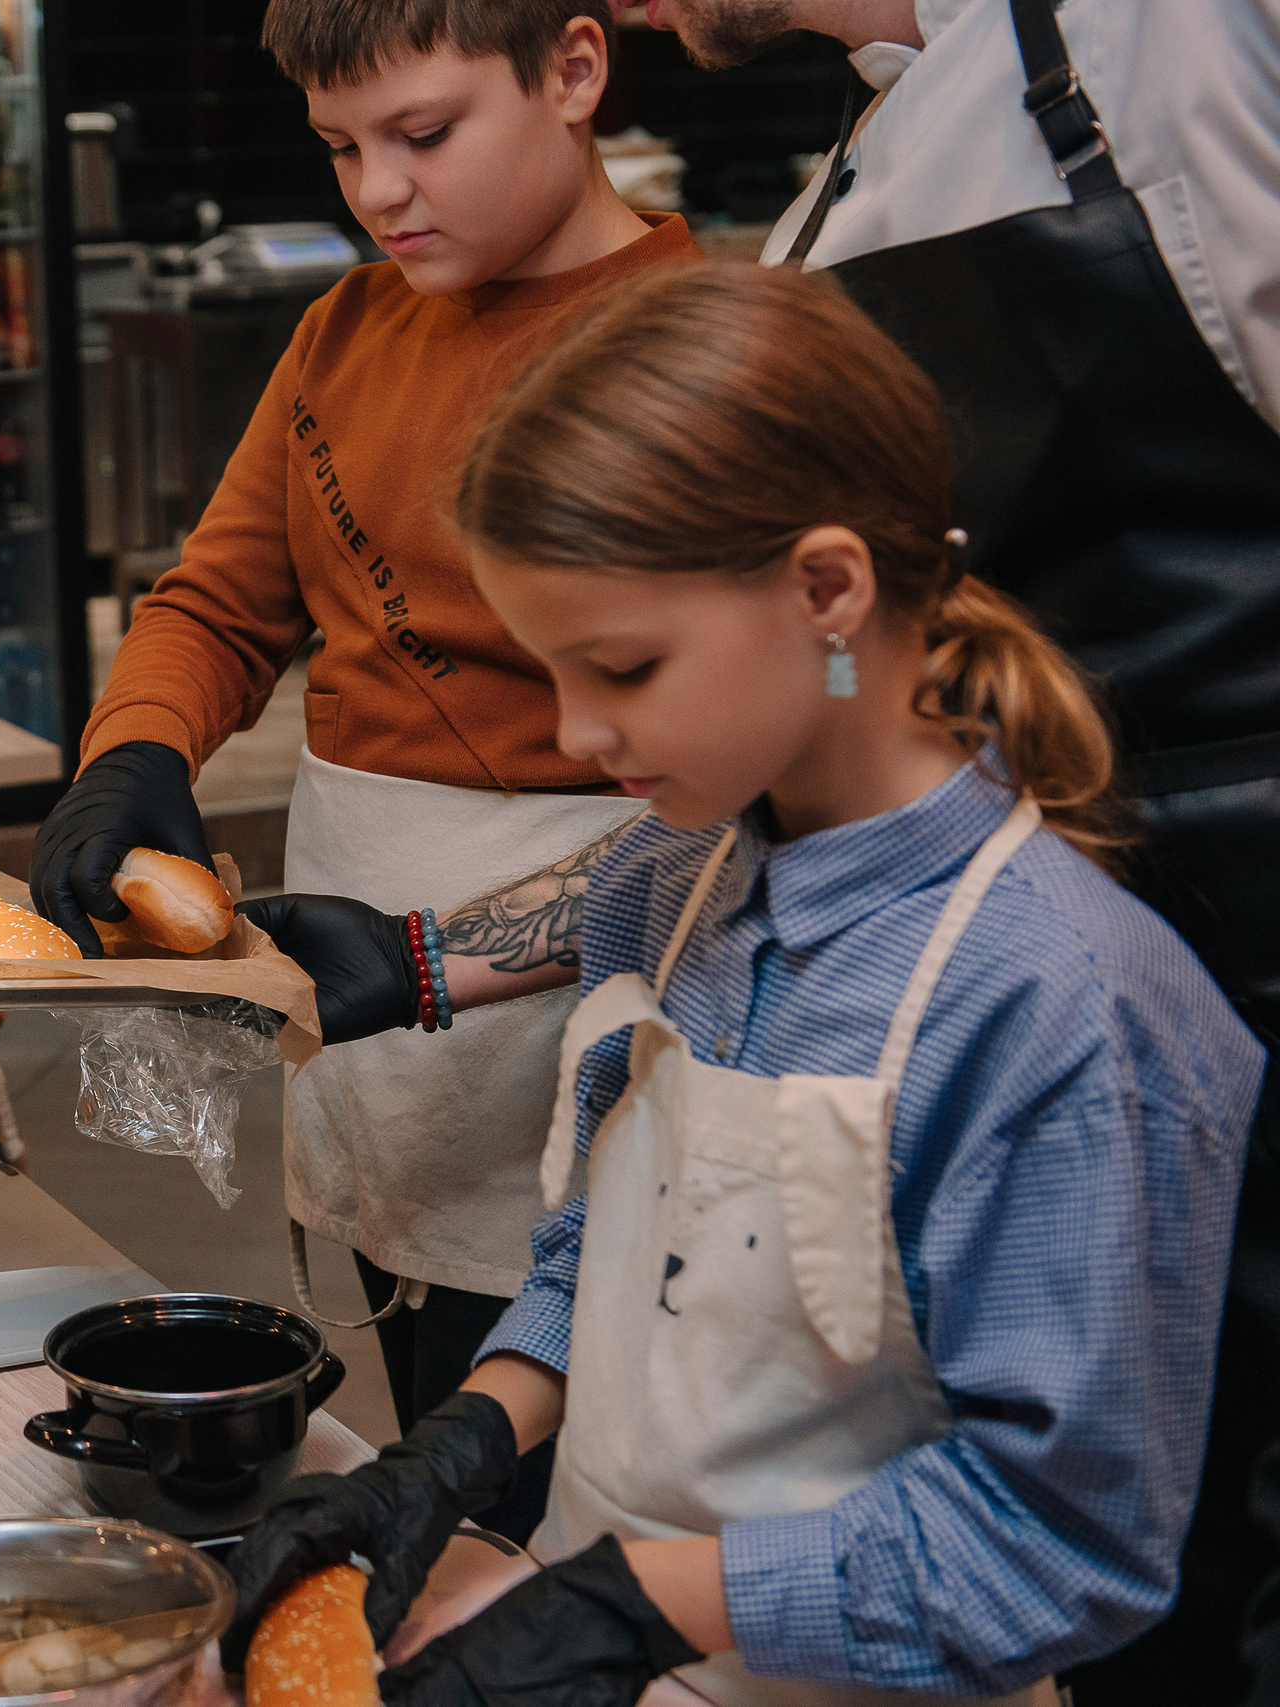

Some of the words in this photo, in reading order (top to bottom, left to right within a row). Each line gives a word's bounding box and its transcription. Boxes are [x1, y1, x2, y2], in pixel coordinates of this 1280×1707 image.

[292, 394, 317, 440] HE
[310, 440, 368, 554] FUTURE
[368, 555, 393, 590] IS
[383, 592, 458, 680] BRIGHT
